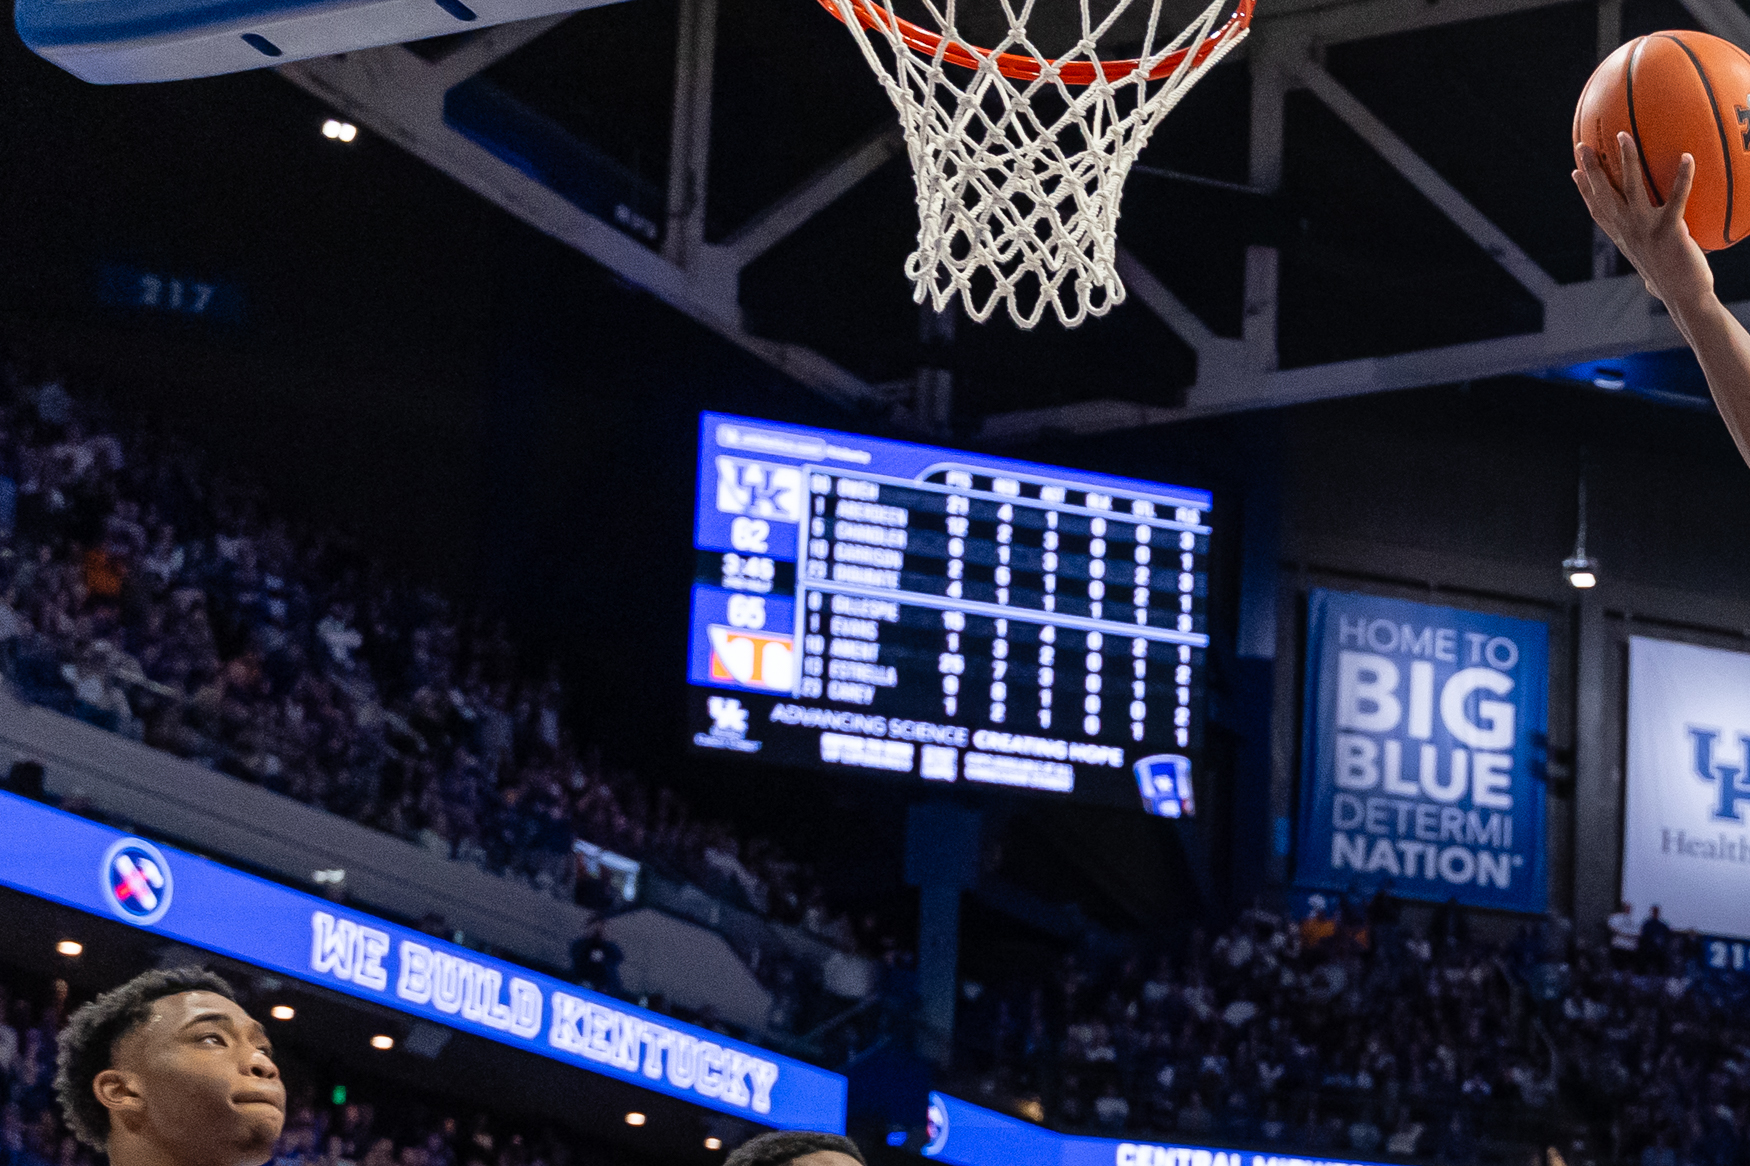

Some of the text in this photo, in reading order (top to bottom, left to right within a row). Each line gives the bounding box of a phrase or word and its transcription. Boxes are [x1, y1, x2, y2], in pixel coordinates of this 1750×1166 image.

[1339, 613, 1519, 671] HOME TO
[771, 703, 888, 736] ADVANCING
[888, 718, 969, 748] SCIENCE
[1337, 650, 1516, 750] BIG
[1334, 733, 1514, 810] BLUE
[1331, 792, 1513, 849] DETERMI
[311, 911, 780, 1114] WE BUILD KENTUCKY
